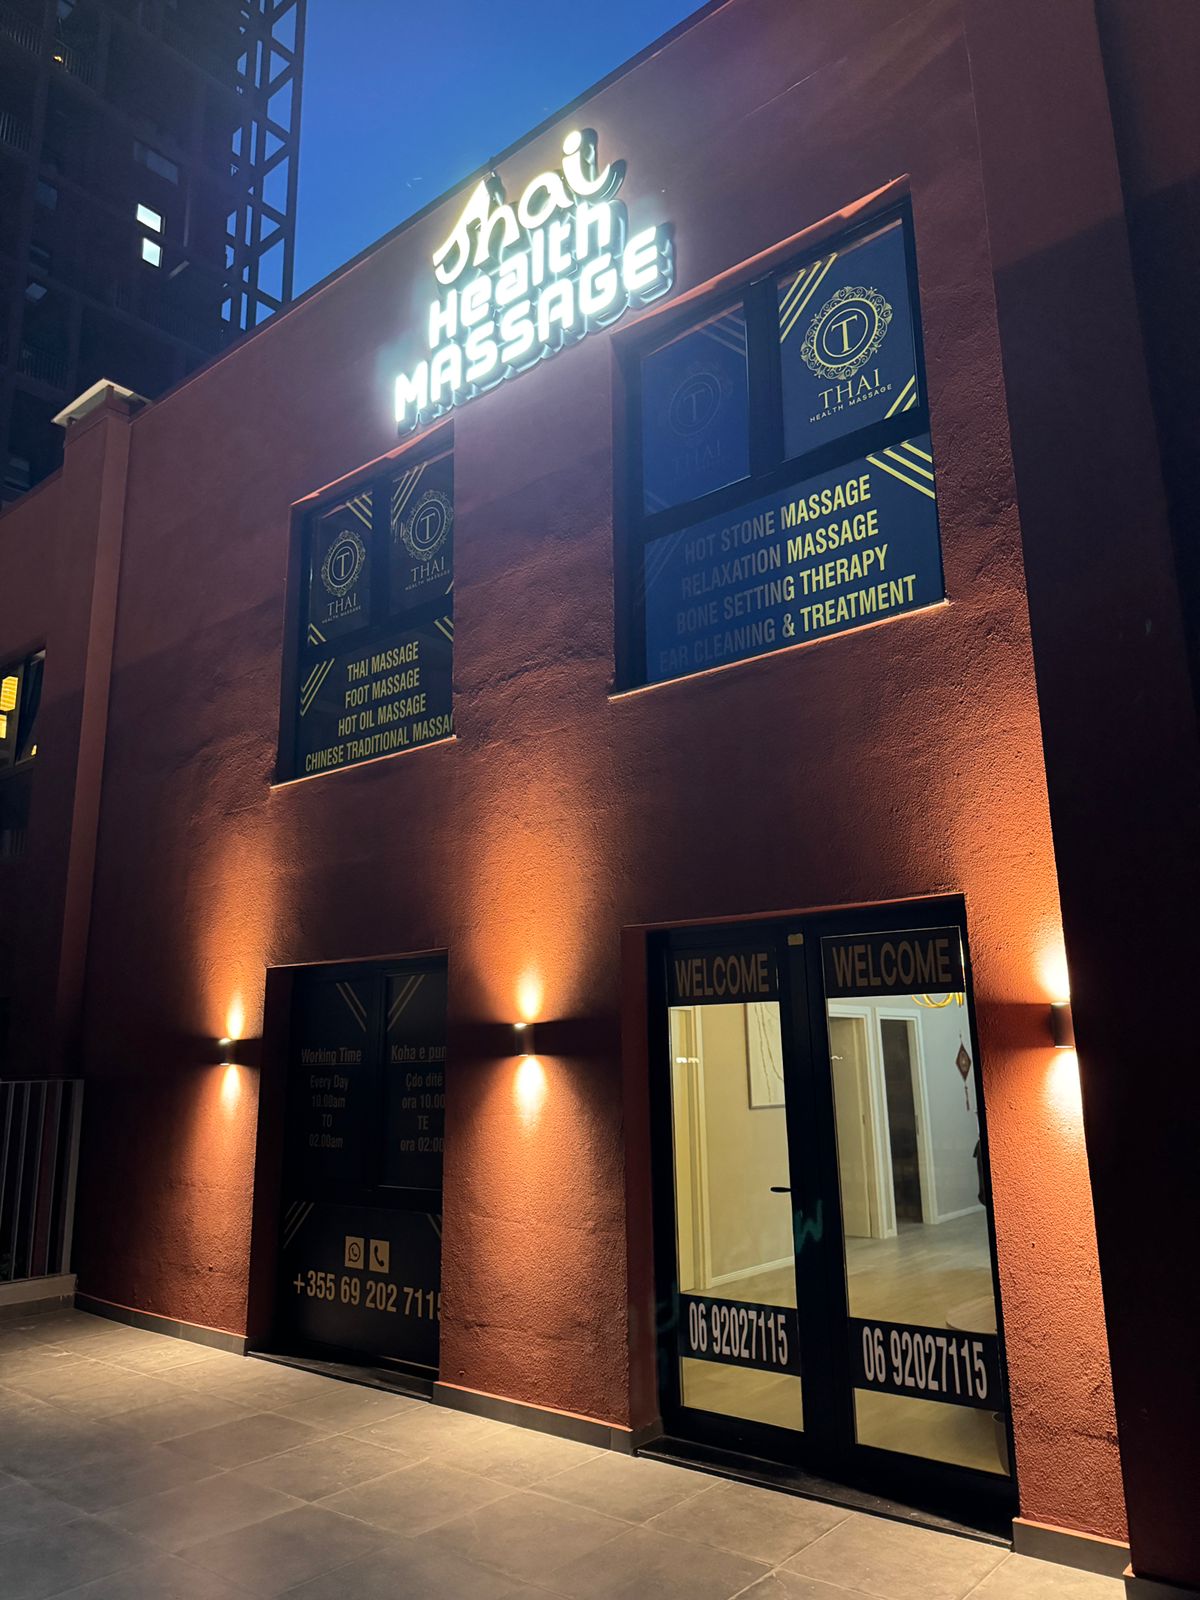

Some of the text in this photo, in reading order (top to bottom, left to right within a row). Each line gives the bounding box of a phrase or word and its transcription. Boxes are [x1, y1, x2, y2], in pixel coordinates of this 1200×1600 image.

[433, 131, 611, 285] Thai
[395, 226, 659, 422] MASSAGE
[831, 314, 858, 354] T
[809, 383, 893, 423] HEALTH MASSAGE
[818, 368, 880, 409] THAI
[420, 513, 435, 541] T
[684, 474, 871, 566] HOT STONE MASSAGE
[336, 552, 349, 578] T
[410, 556, 444, 582] THAI
[681, 509, 879, 600] RELAXATION MASSAGE
[327, 593, 357, 616] THAI
[677, 544, 888, 635] BONE SETTING THERAPY
[659, 574, 917, 673] EAR CLEANING & TREATMENT
[347, 641, 419, 682] THAI MASSAGE
[345, 668, 420, 709] FOOT MASSAGE
[338, 693, 427, 737] HOT OIL MASSAGE
[305, 745, 344, 772] CHINESE
[346, 726, 410, 760] TRADITIONAL
[675, 952, 770, 998] WELCOME
[832, 938, 953, 988] WELCOME
[301, 1046, 362, 1066] Working Time
[391, 1044, 416, 1061] Koha
[418, 1047, 426, 1060] e
[310, 1074, 350, 1091] Every Day
[401, 1096, 418, 1109] ora
[321, 1114, 333, 1128] TO
[400, 1138, 415, 1151] ora
[293, 1270, 336, 1301] +355
[340, 1275, 361, 1306] 69
[365, 1280, 398, 1313] 202
[688, 1301, 789, 1366] 06 92027115
[862, 1325, 989, 1400] 06 92027115
